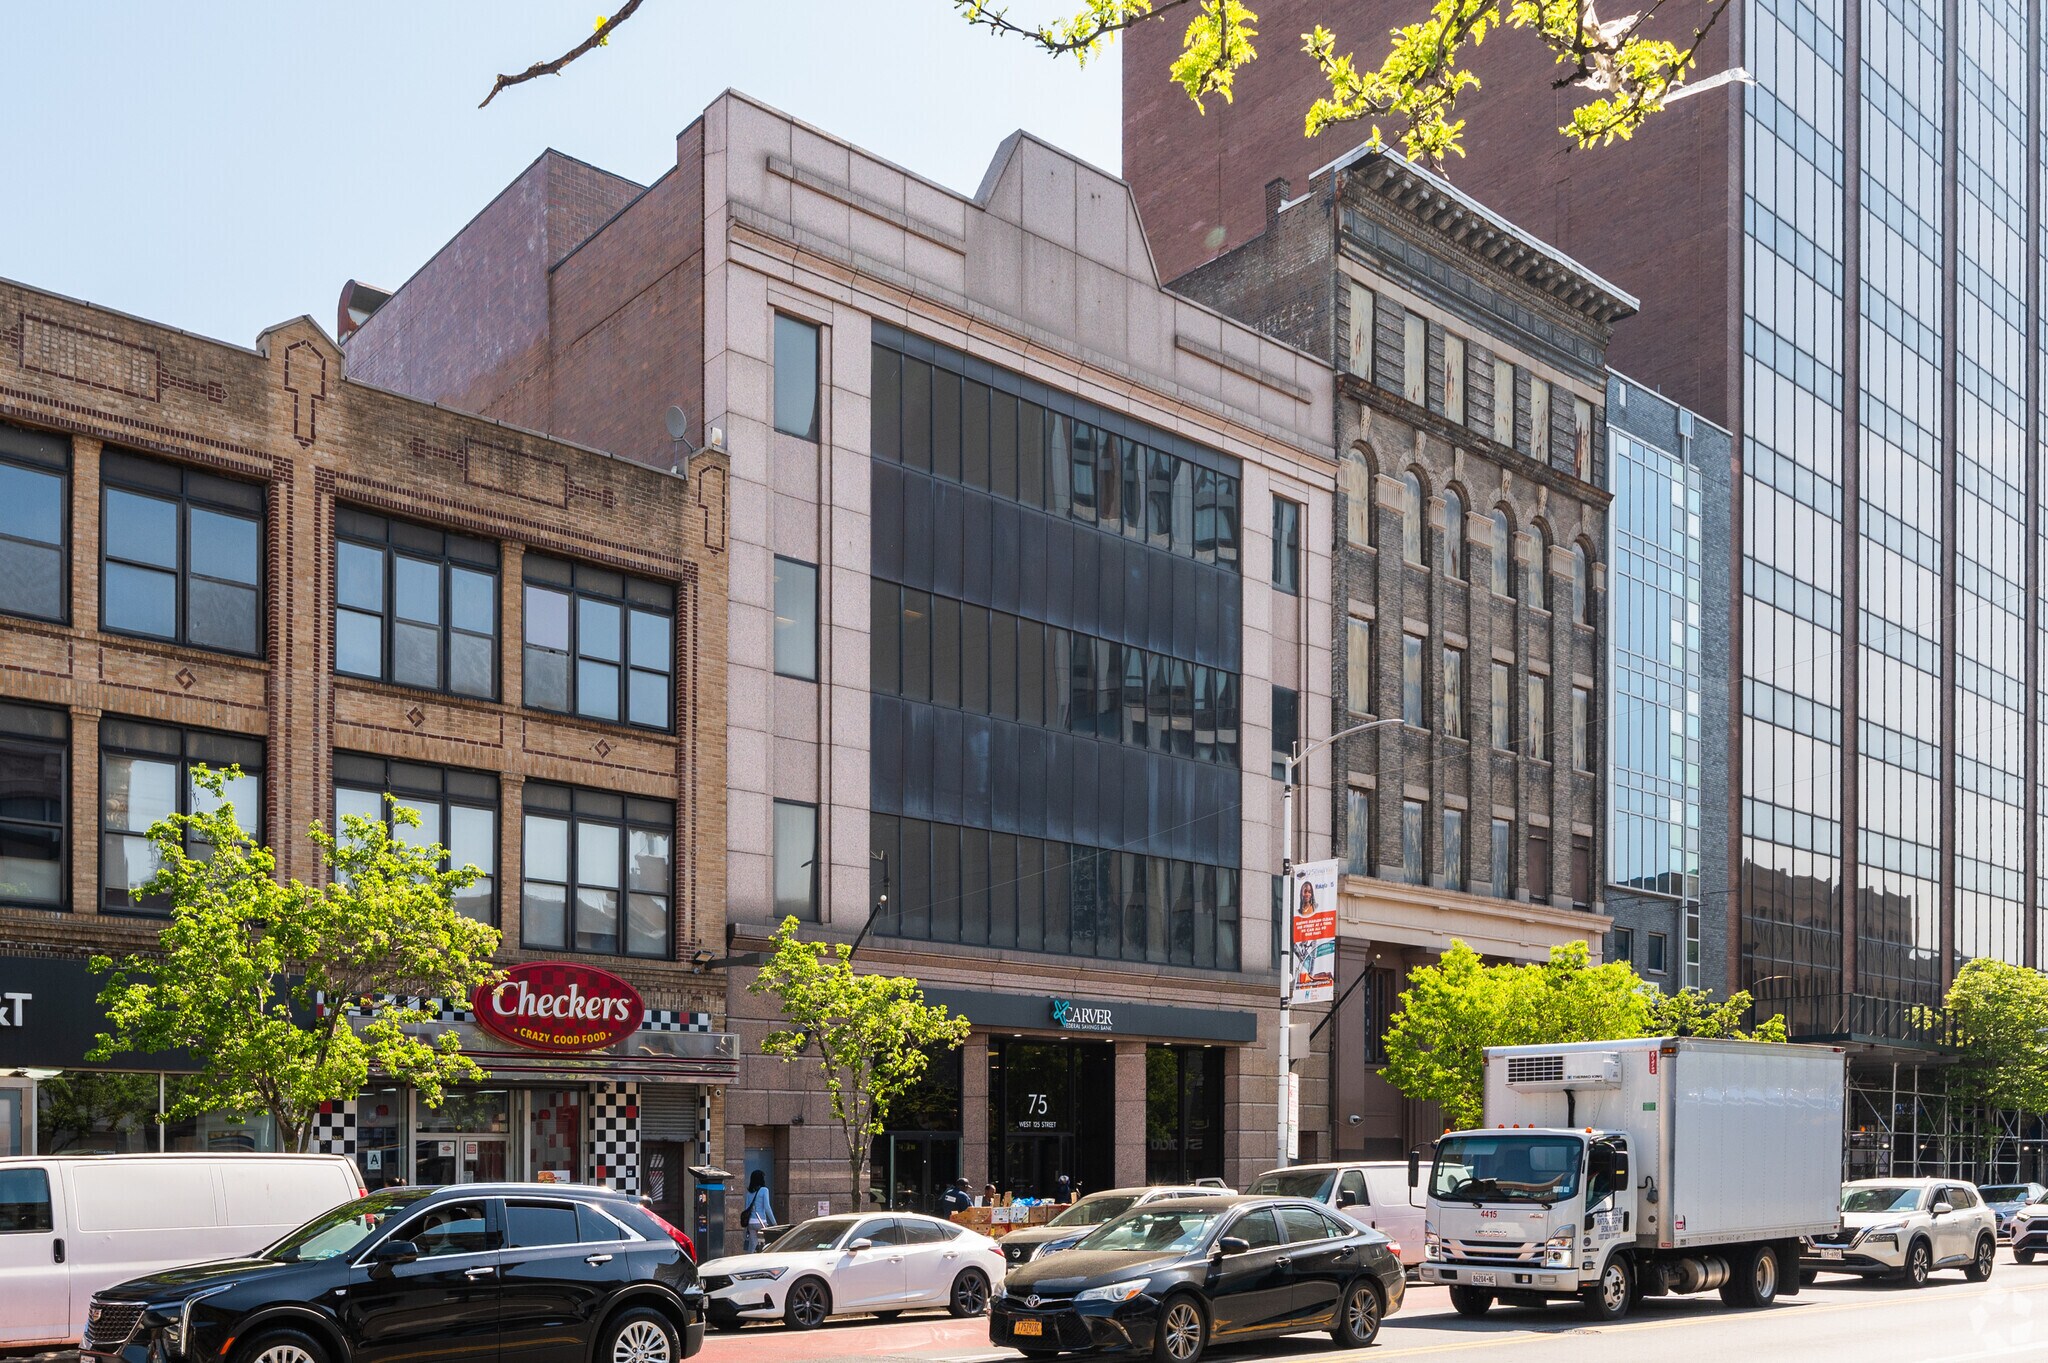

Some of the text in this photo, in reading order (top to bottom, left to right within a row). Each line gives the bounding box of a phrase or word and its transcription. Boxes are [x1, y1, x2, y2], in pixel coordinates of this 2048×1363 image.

[491, 980, 630, 1021] Checkers
[1063, 1006, 1113, 1025] CARVER
[520, 1027, 606, 1045] CRAZY GOOD FOOD
[1028, 1094, 1047, 1114] 75
[370, 1154, 379, 1165] A
[1480, 1210, 1497, 1218] 4415
